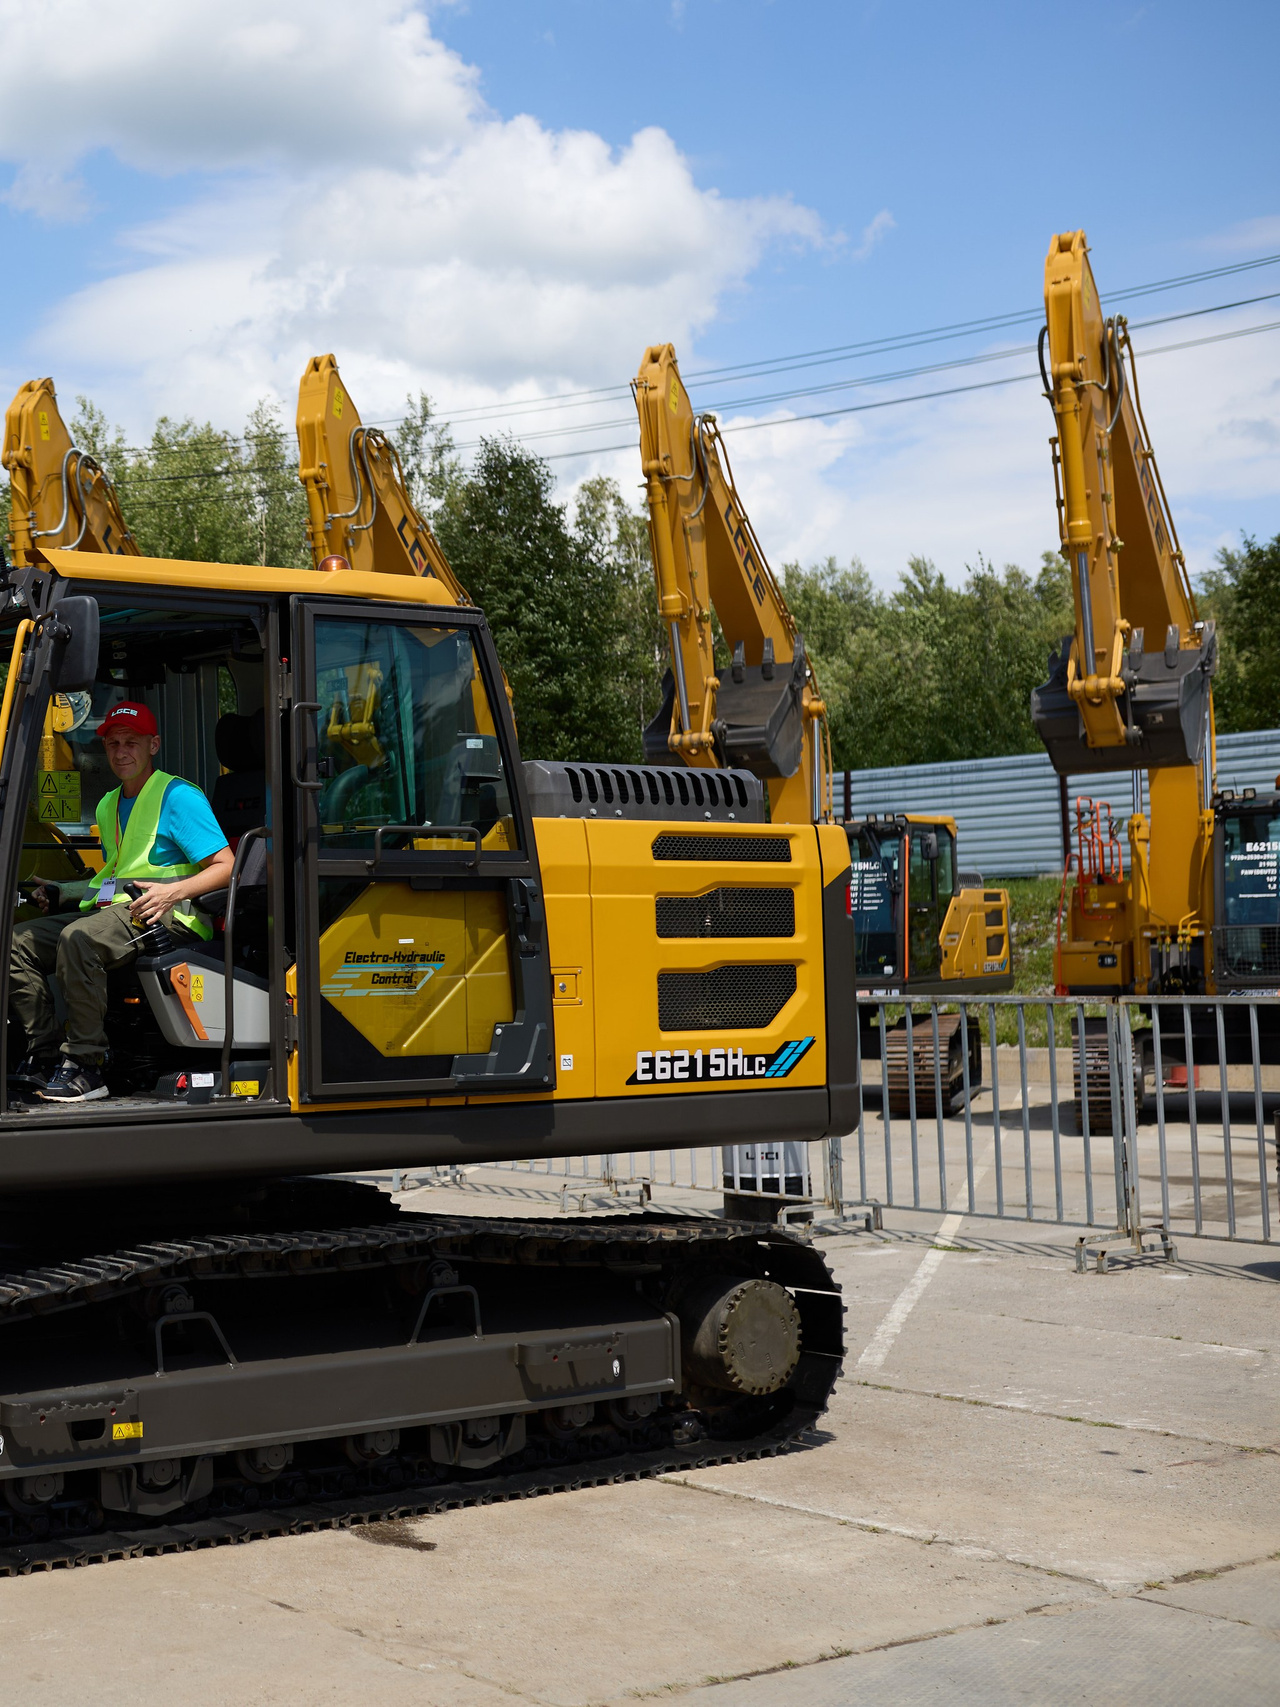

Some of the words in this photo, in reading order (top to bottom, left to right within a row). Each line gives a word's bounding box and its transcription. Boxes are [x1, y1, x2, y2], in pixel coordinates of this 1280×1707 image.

[724, 502, 766, 607] LGCE
[1246, 841, 1280, 852] E6215
[344, 951, 445, 963] Electro-Hydraulic
[371, 973, 413, 984] Control
[636, 1047, 766, 1081] E6215HLC
